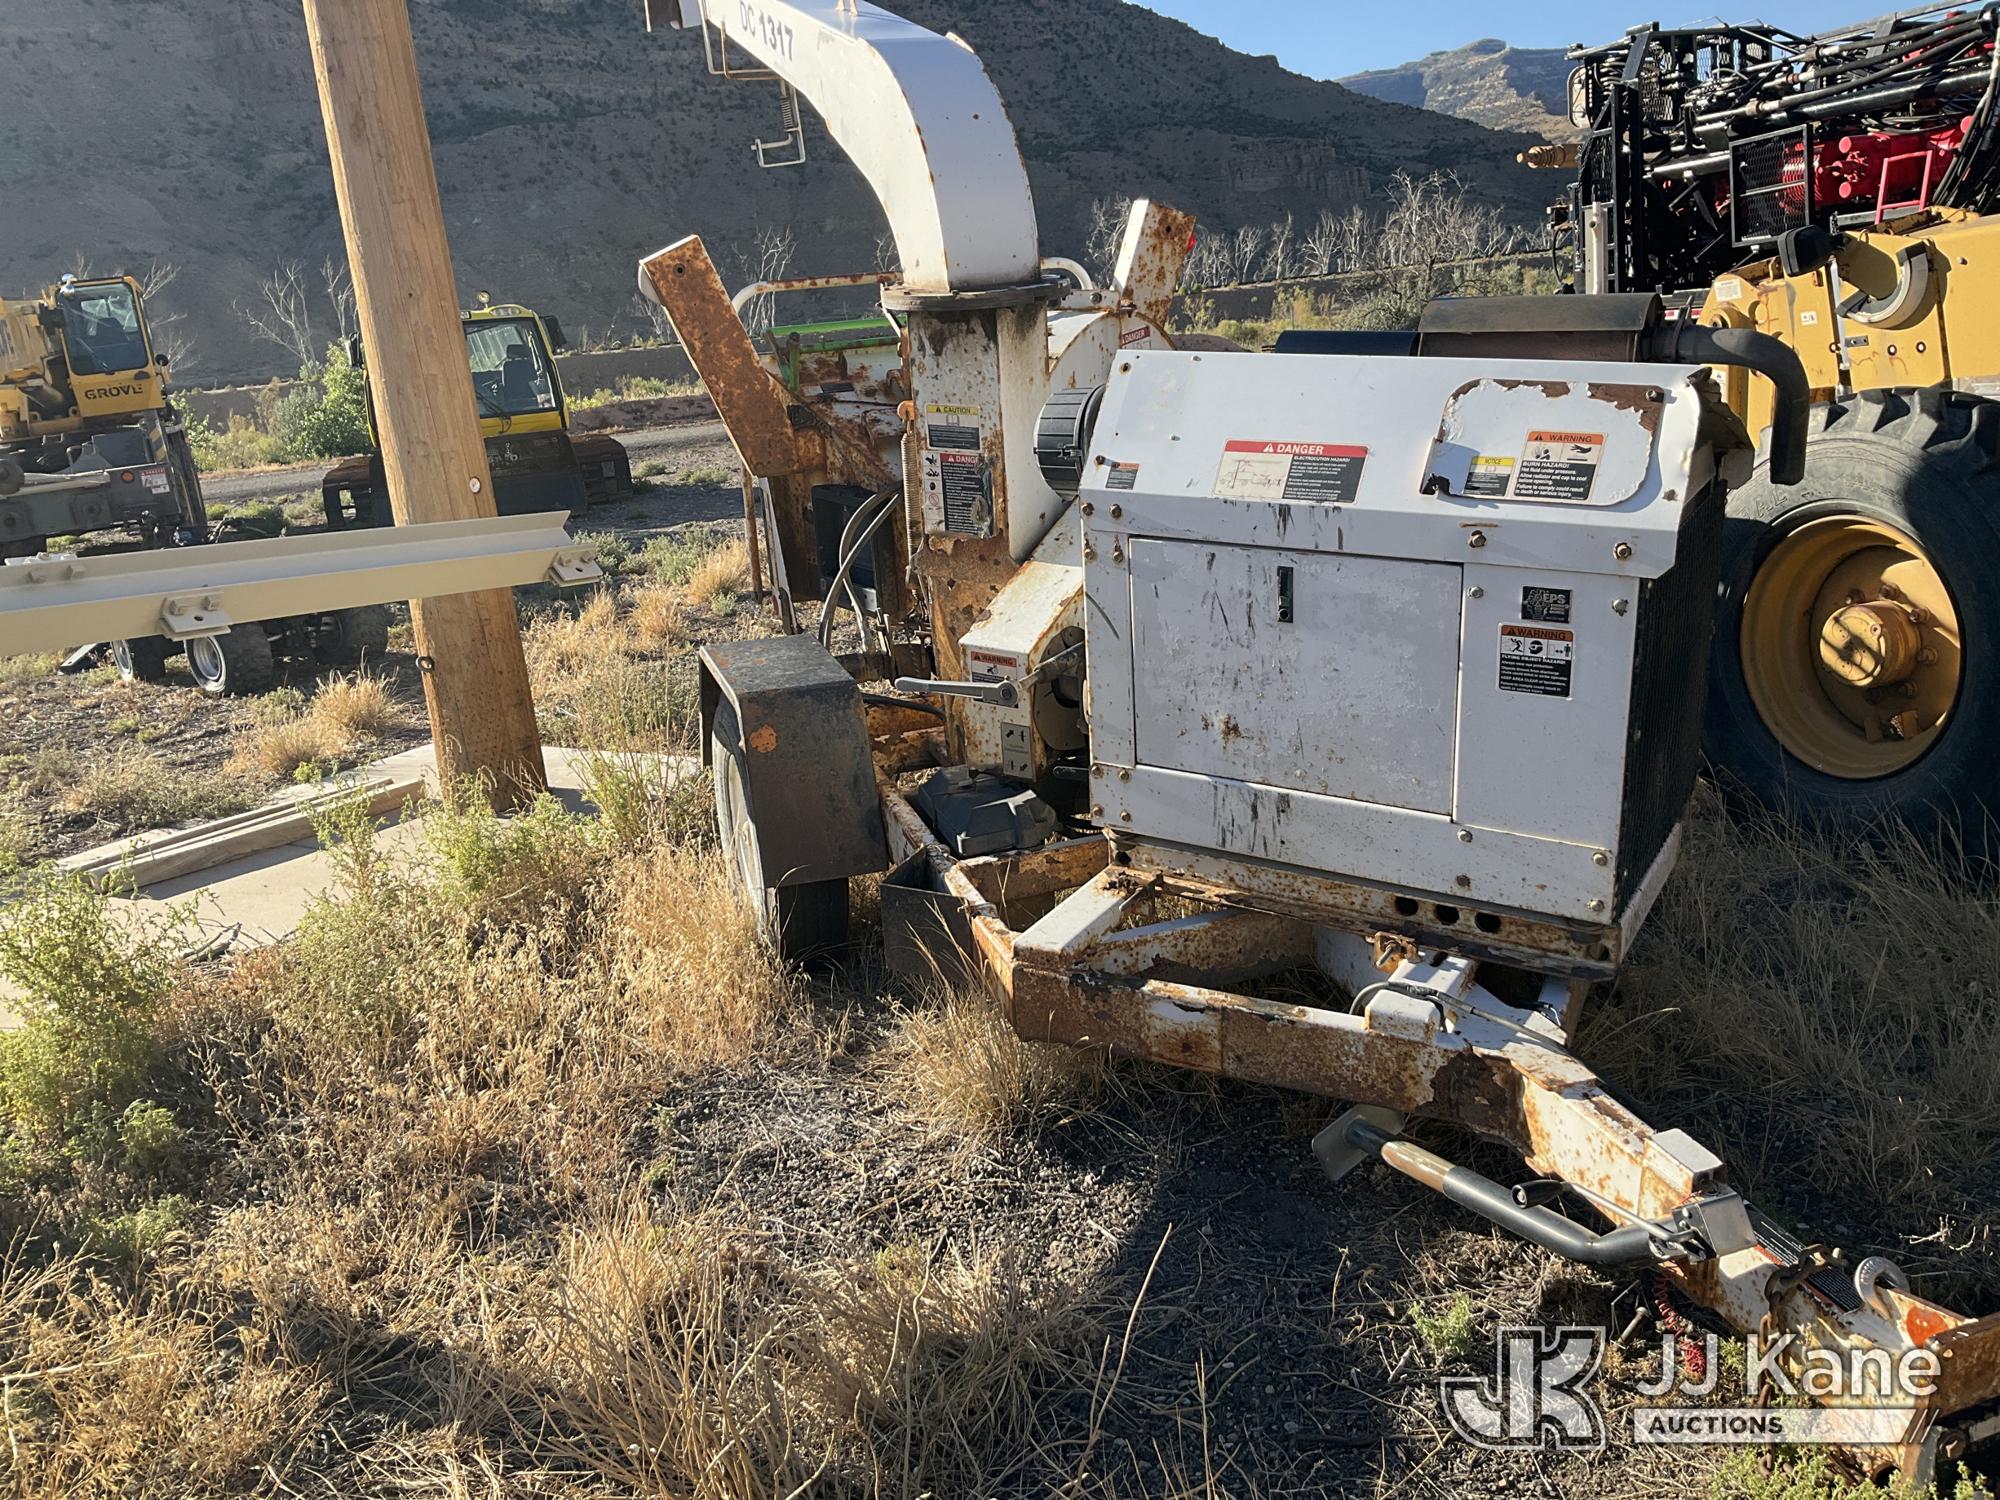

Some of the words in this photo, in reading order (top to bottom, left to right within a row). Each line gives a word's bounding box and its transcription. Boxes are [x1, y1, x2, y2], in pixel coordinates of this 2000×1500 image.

[740, 0, 755, 37] DC
[759, 10, 793, 61] 1317
[85, 383, 143, 399] GROVE
[944, 406, 970, 414] CAUTION
[1549, 434, 1592, 443] WARNING
[1276, 443, 1324, 454] DANGER
[1517, 628, 1566, 640] WARNING
[982, 655, 1013, 665] WARNING
